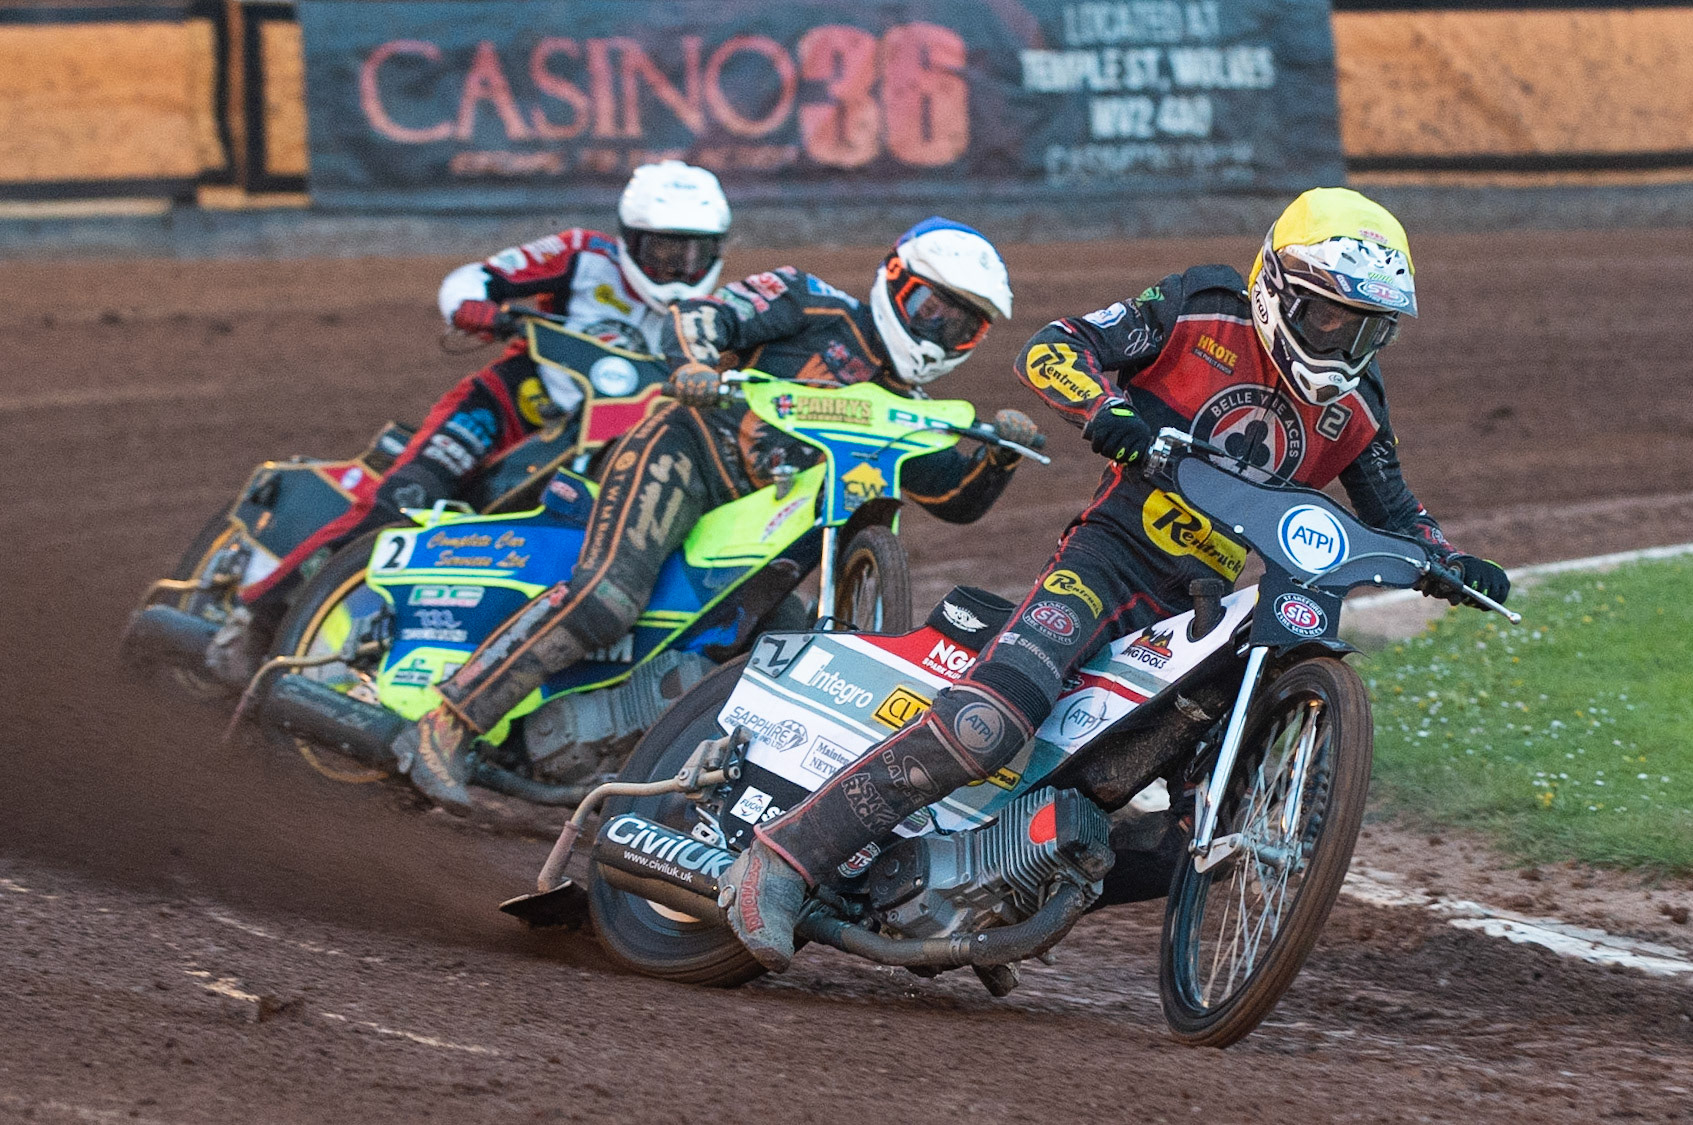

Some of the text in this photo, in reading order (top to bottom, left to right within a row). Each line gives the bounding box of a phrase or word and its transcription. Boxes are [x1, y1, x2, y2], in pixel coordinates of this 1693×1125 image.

[359, 22, 969, 168] CASINO 36
[1198, 334, 1238, 367] HYCOTE
[1031, 344, 1091, 399] Rentruck
[1210, 391, 1299, 458] BELLE VE ACES
[1321, 405, 1346, 435] 2
[1153, 494, 1241, 574] Rentruck
[1291, 525, 1334, 553] ATPI
[381, 535, 407, 569] 2
[1049, 573, 1100, 616] Rentruck
[1037, 609, 1067, 630] STS
[1286, 604, 1312, 624] STS
[922, 658, 946, 676] SPARK
[810, 664, 874, 709] integro
[729, 705, 792, 743] SAPPHIRE
[966, 710, 993, 742] ATPI
[740, 799, 764, 813] FUCHS
[623, 850, 693, 883] www.civiluk.uk
